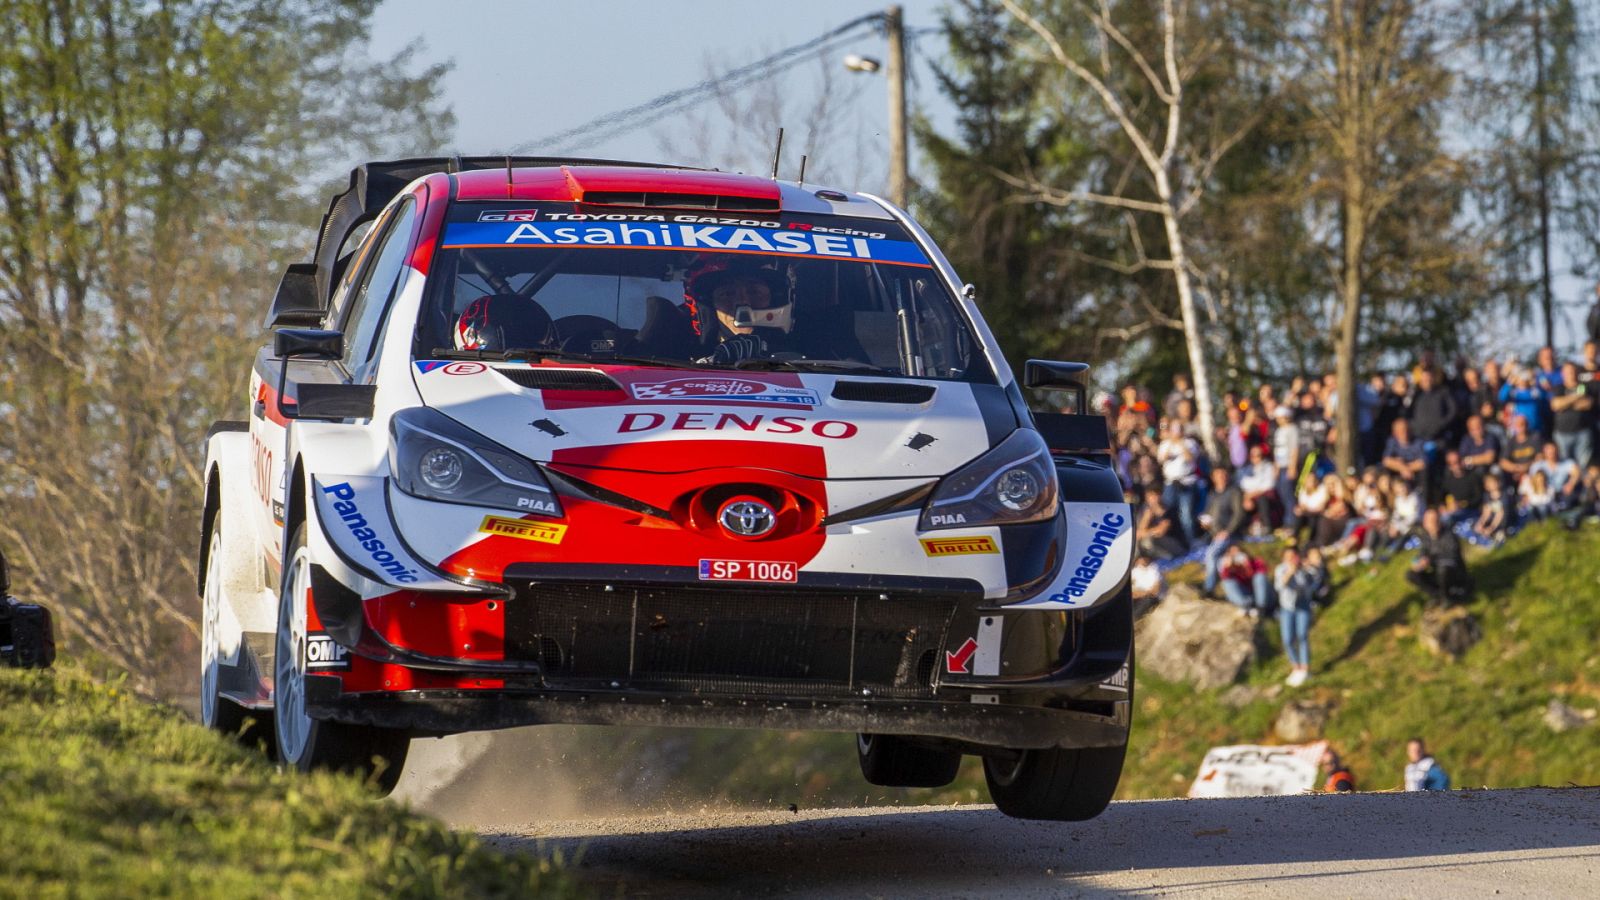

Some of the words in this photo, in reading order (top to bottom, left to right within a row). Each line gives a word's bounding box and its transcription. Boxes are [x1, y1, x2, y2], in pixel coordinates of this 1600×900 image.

[480, 213, 534, 222] GR
[545, 213, 666, 222] TOYOTA
[673, 215, 781, 228] GAZOO
[788, 222, 886, 239] Racing
[616, 412, 859, 440] DENSO
[516, 497, 556, 513] PIAA
[486, 518, 560, 540] PIRELLI
[930, 513, 967, 526] PIAA
[322, 482, 419, 584] Panasonic
[926, 538, 993, 554] PIRELLI
[1050, 512, 1125, 605] Panasonic
[713, 561, 741, 578] SP
[747, 562, 793, 581] 1006
[307, 640, 347, 662] OMP
